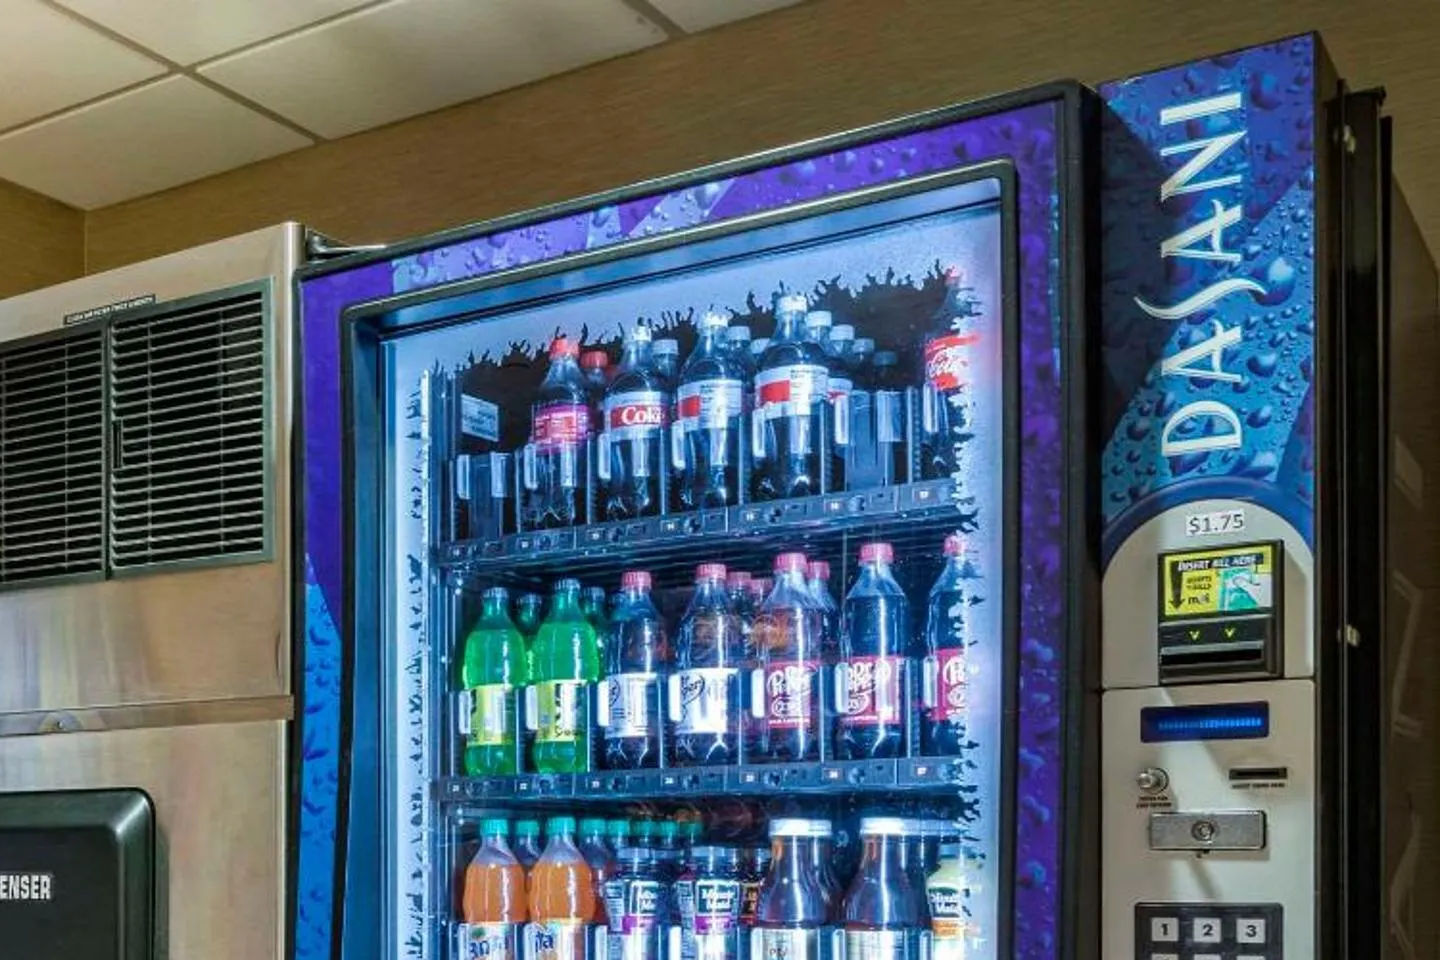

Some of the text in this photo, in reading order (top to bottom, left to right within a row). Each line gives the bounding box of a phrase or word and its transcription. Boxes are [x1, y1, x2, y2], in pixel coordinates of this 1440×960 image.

[1134, 91, 1268, 459] DASANI
[622, 406, 665, 425] Coke
[1189, 514, 1244, 535] $1.75
[1160, 923, 1169, 936] 1
[1203, 923, 1213, 937] 2
[1246, 925, 1257, 938] 3
